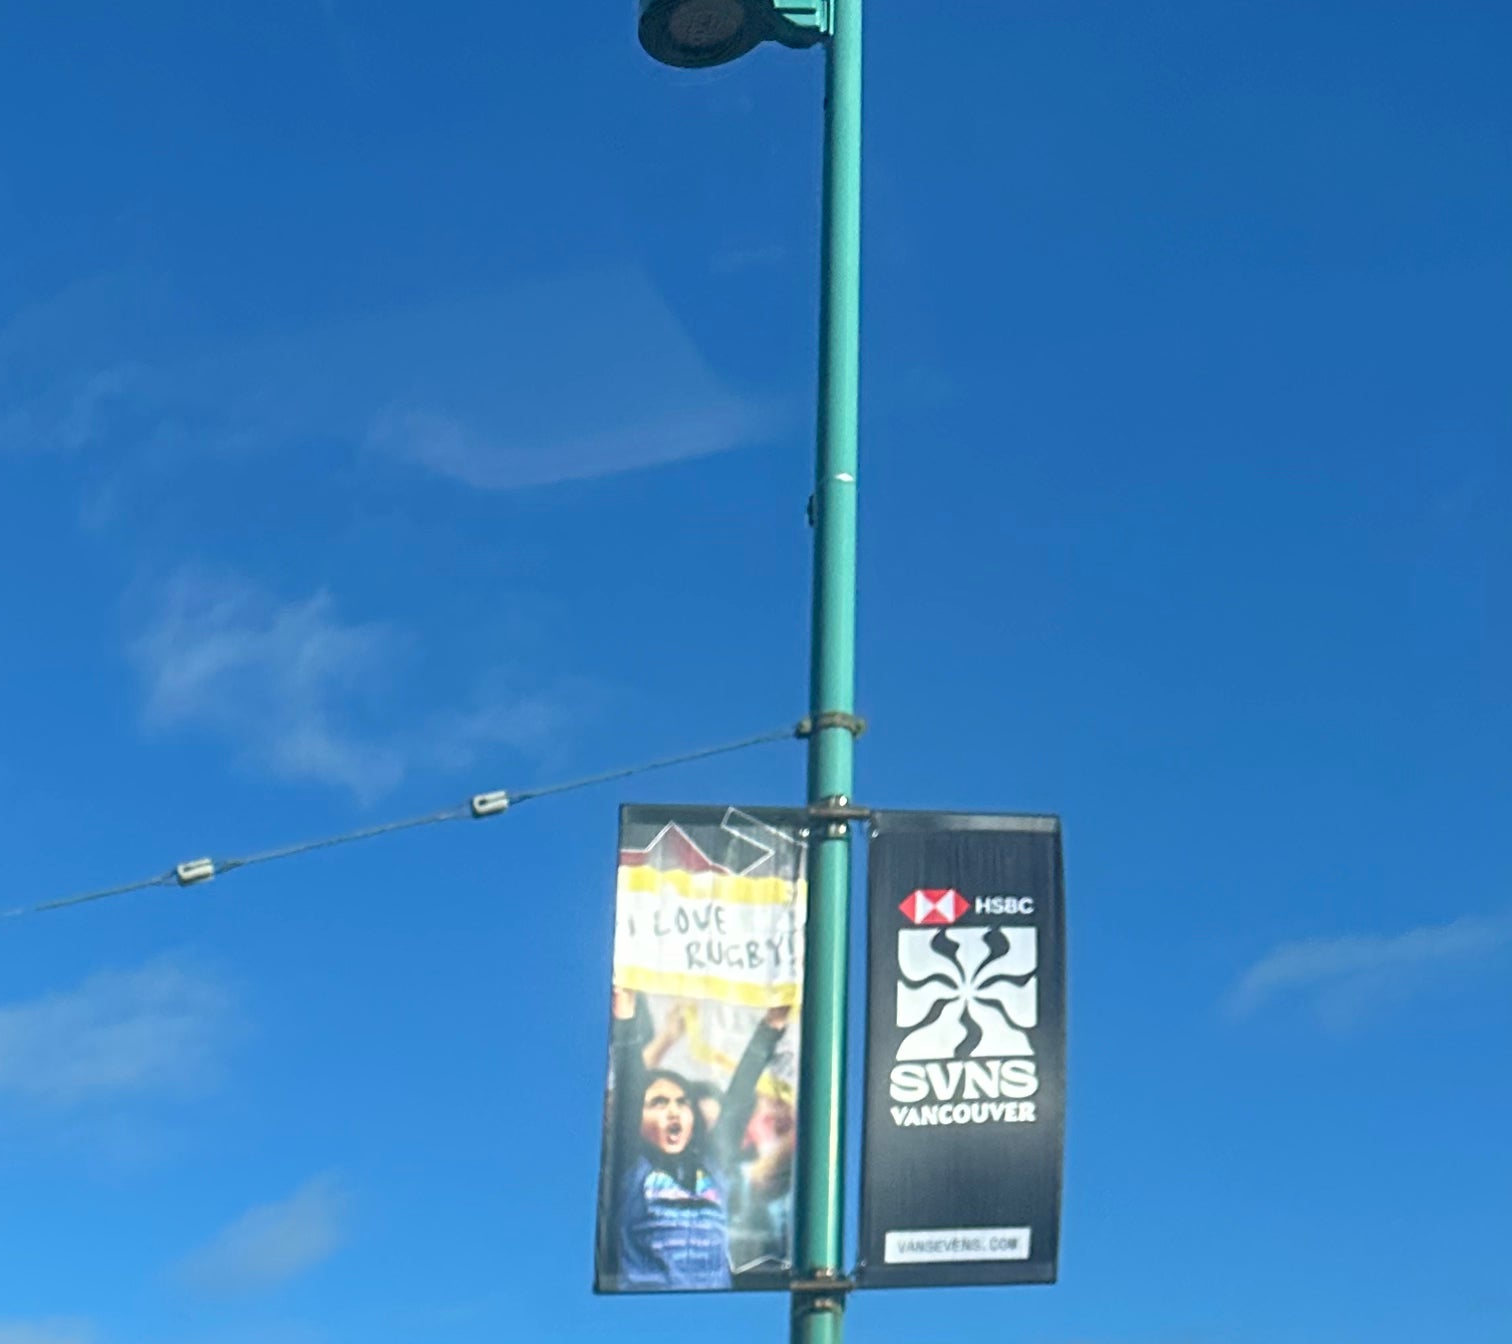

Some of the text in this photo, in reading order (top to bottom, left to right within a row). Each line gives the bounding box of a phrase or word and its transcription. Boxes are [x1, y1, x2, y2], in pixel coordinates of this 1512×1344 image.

[974, 896, 1035, 914] HSBC
[628, 903, 727, 937] I LOVE
[889, 1059, 1039, 1103] SVNS
[890, 1101, 1036, 1127] VANCOUVER
[896, 1236, 1018, 1254] VANSEVENS.COM
